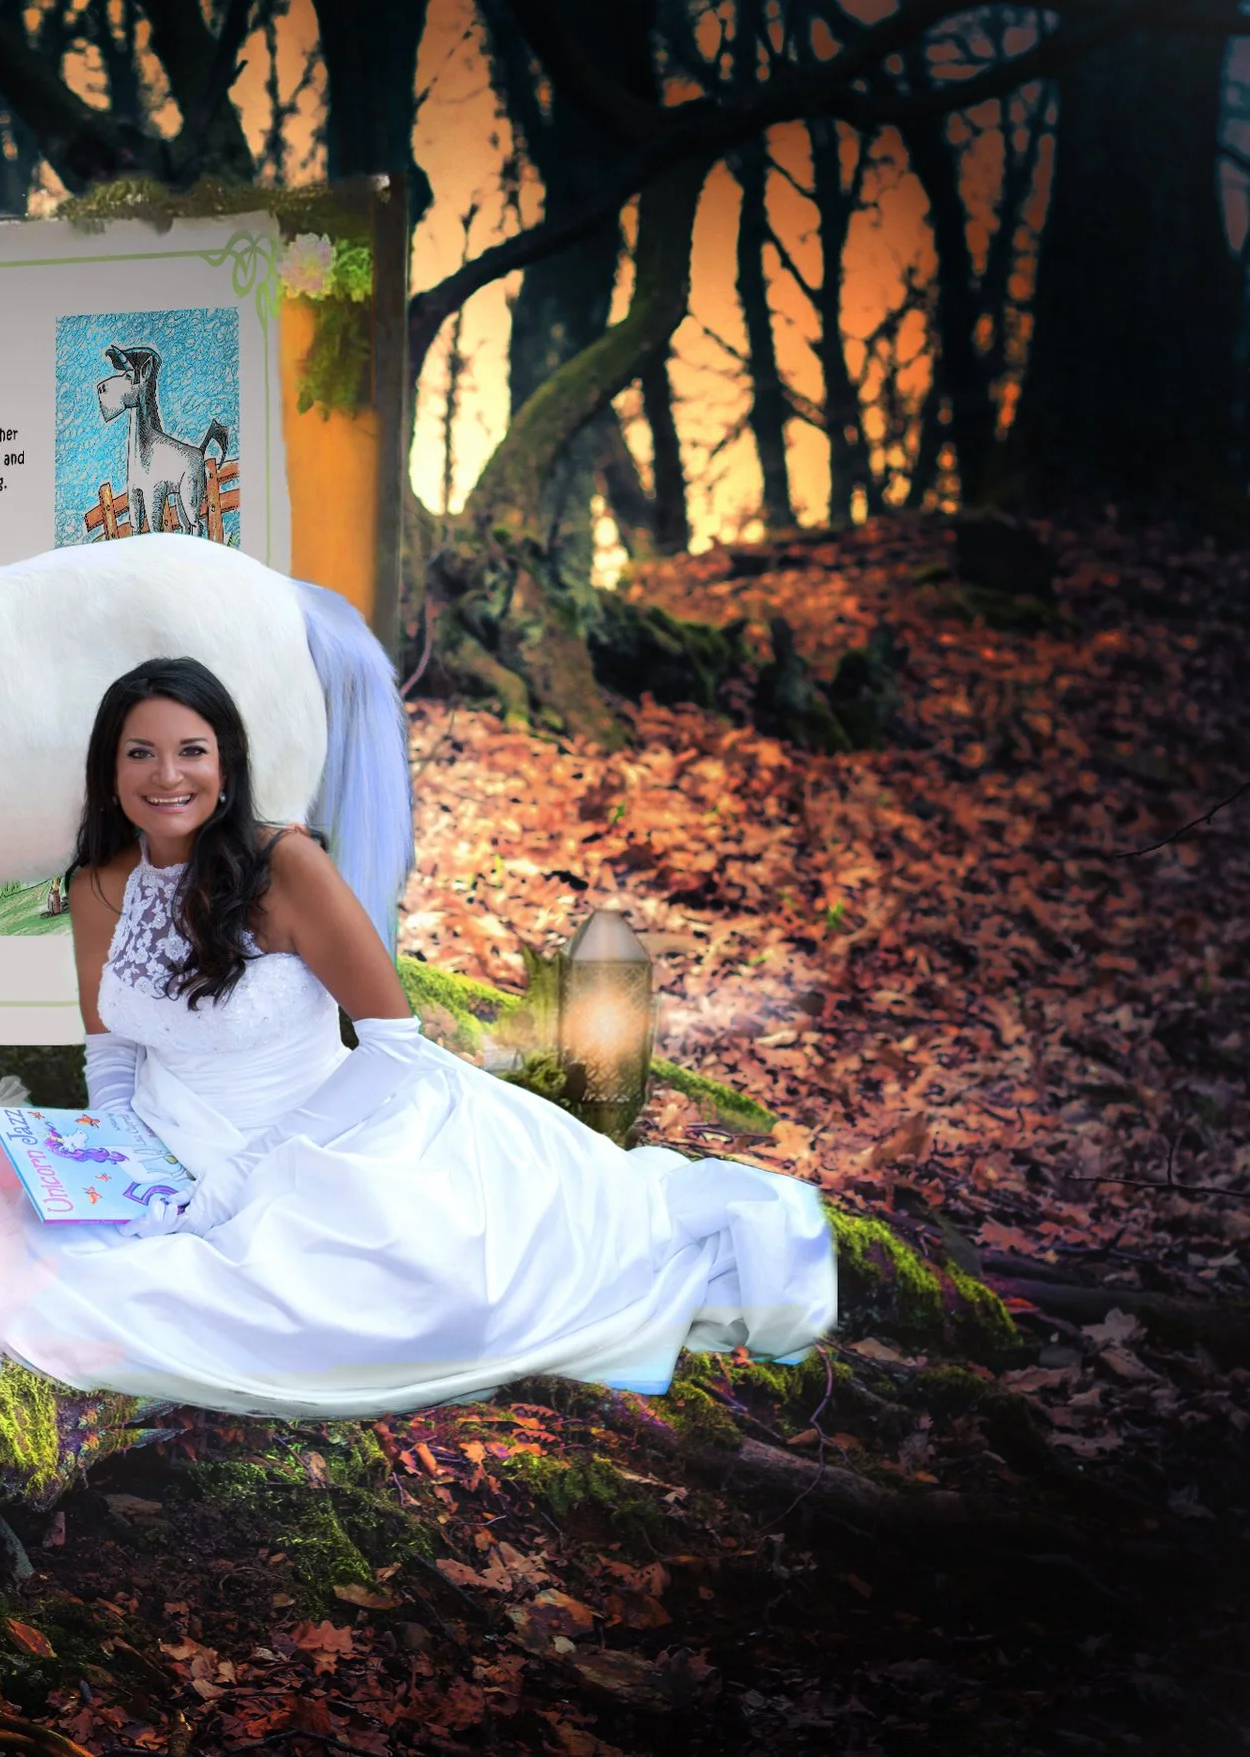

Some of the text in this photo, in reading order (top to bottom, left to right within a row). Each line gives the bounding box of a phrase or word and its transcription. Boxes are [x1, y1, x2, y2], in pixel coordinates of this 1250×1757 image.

[3, 450, 25, 468] and
[3, 1109, 75, 1213] Unicorn Jazz
